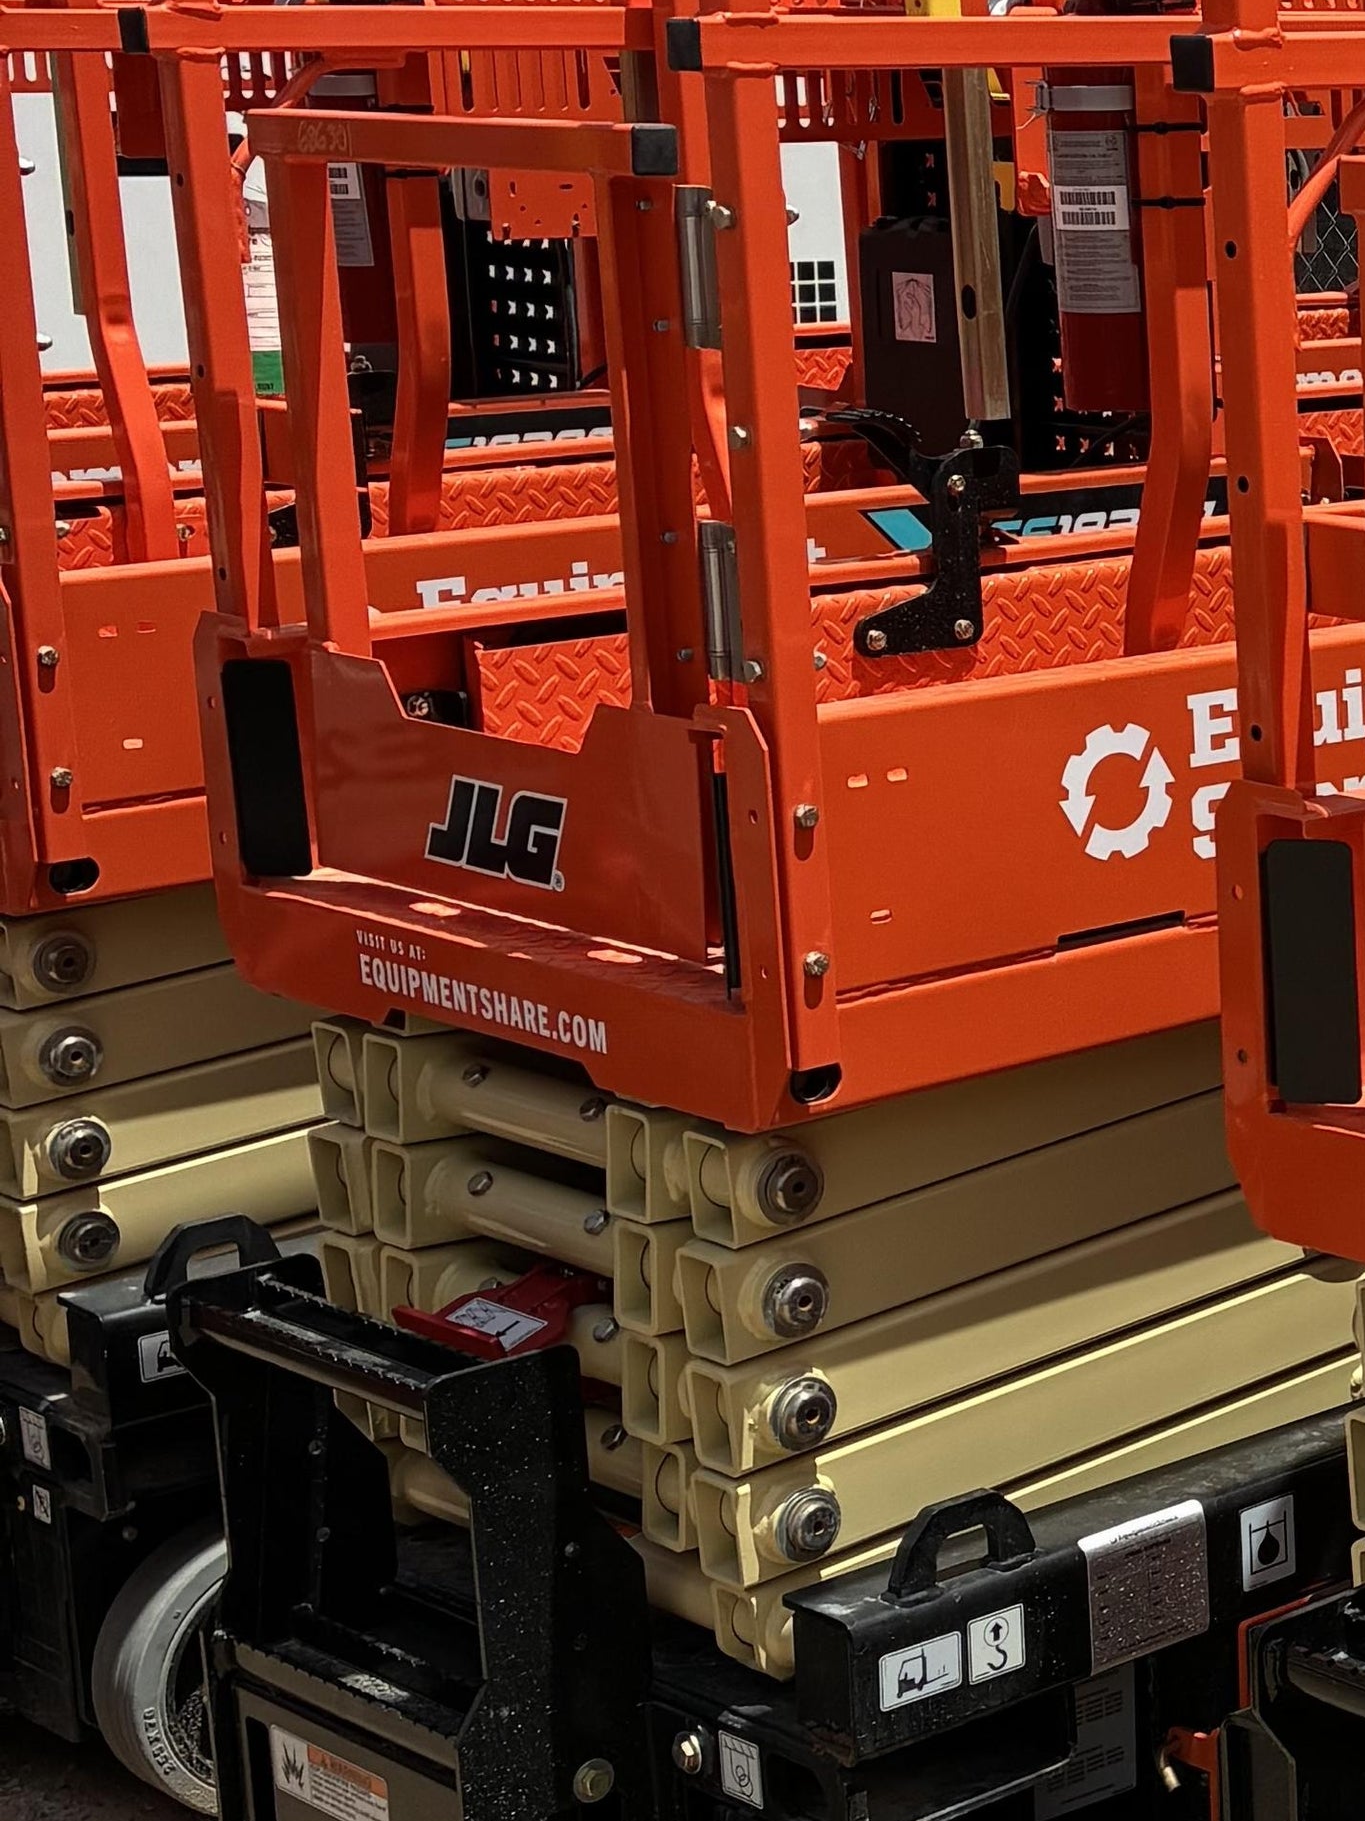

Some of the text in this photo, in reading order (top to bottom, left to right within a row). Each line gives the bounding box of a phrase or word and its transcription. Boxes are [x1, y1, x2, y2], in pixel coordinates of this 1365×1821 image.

[356, 929, 427, 961] VISIT US AT:
[359, 953, 608, 1055] EQUIPMENTSHARE.COM
